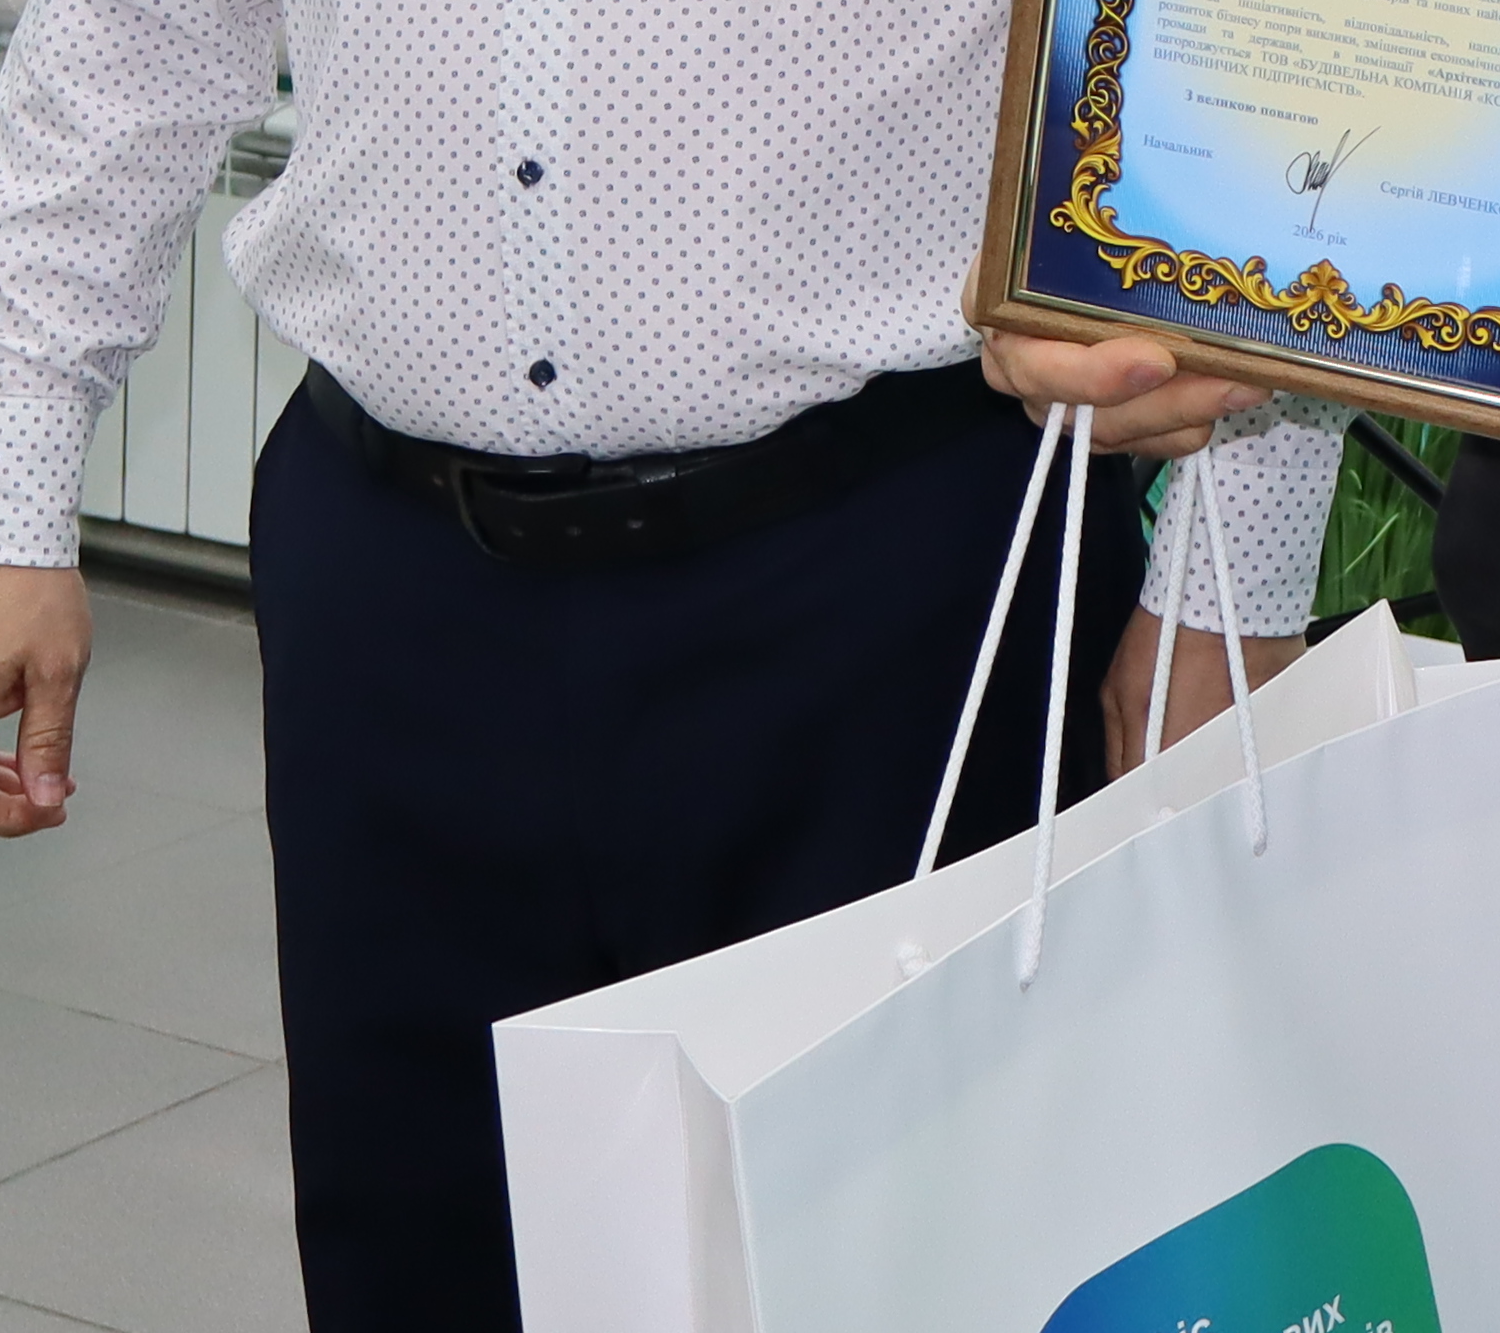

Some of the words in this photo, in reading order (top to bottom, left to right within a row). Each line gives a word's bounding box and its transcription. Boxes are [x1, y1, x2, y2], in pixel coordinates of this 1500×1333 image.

[1433, 0, 1471, 17] нових
[1156, 16, 1208, 35] громади
[1221, 28, 1235, 40] та
[1332, 50, 1341, 60] в
[1354, 53, 1415, 74] номінації
[1157, 0, 1214, 19] розвиток
[1215, 8, 1262, 31] бізнесу
[1263, 20, 1303, 37] попри
[1363, 38, 1427, 60] зміцнення
[1153, 46, 1250, 77] ВИРОБНИЧИХ
[1251, 65, 1366, 99] ПІДПРИЄМСТВ».
[1154, 33, 1252, 60] нагороджується
[1260, 50, 1289, 67] ТОВ
[1292, 57, 1390, 87] «БУДІВЕЛЬНА
[1393, 75, 1474, 102] КОМПАНІЯ
[1185, 88, 1194, 102] З
[1196, 94, 1257, 114] великою
[1259, 106, 1319, 126] повагою
[1143, 133, 1214, 159] Начальник
[1379, 180, 1424, 201] Сергій
[1292, 223, 1325, 242] 2026
[1326, 231, 1348, 247] рік
